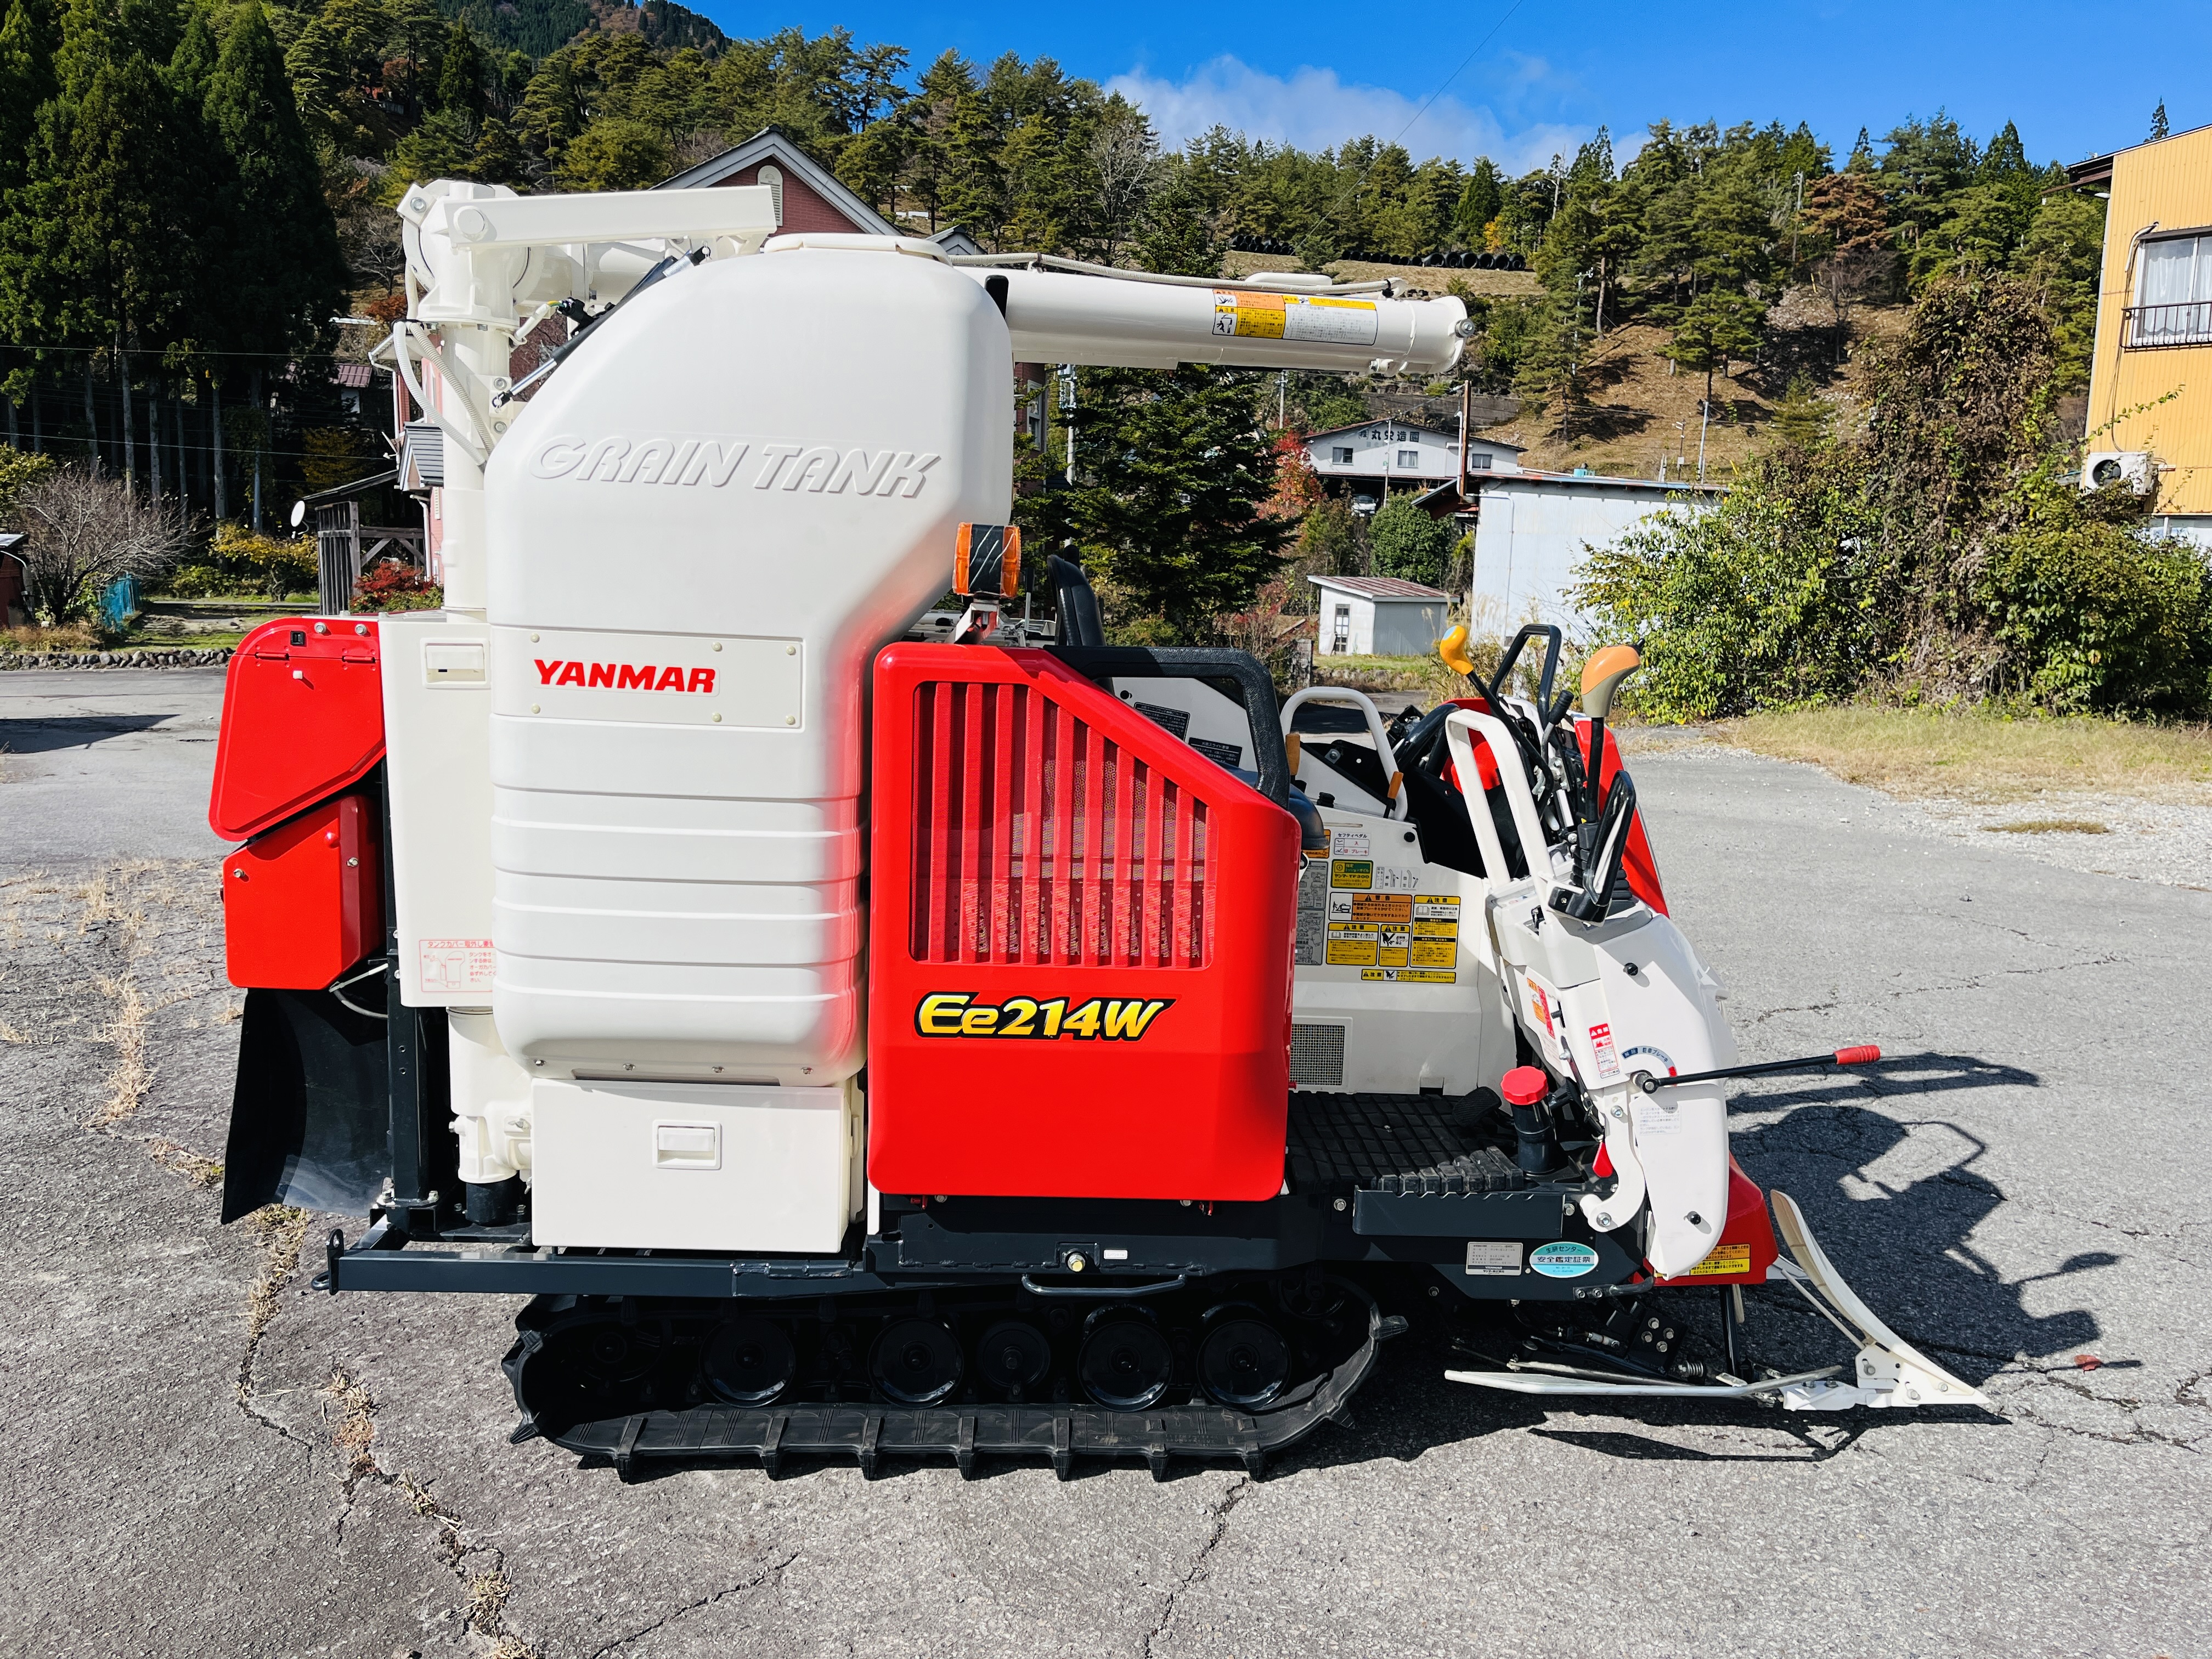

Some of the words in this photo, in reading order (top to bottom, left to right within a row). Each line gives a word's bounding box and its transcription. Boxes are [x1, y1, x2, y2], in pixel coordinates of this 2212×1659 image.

[528, 436, 749, 488] GRAIN
[753, 443, 941, 499] TANK
[534, 659, 716, 693] YANMAR
[915, 992, 1173, 1040] Ee214W
[1546, 1246, 1583, 1254] 生研センター
